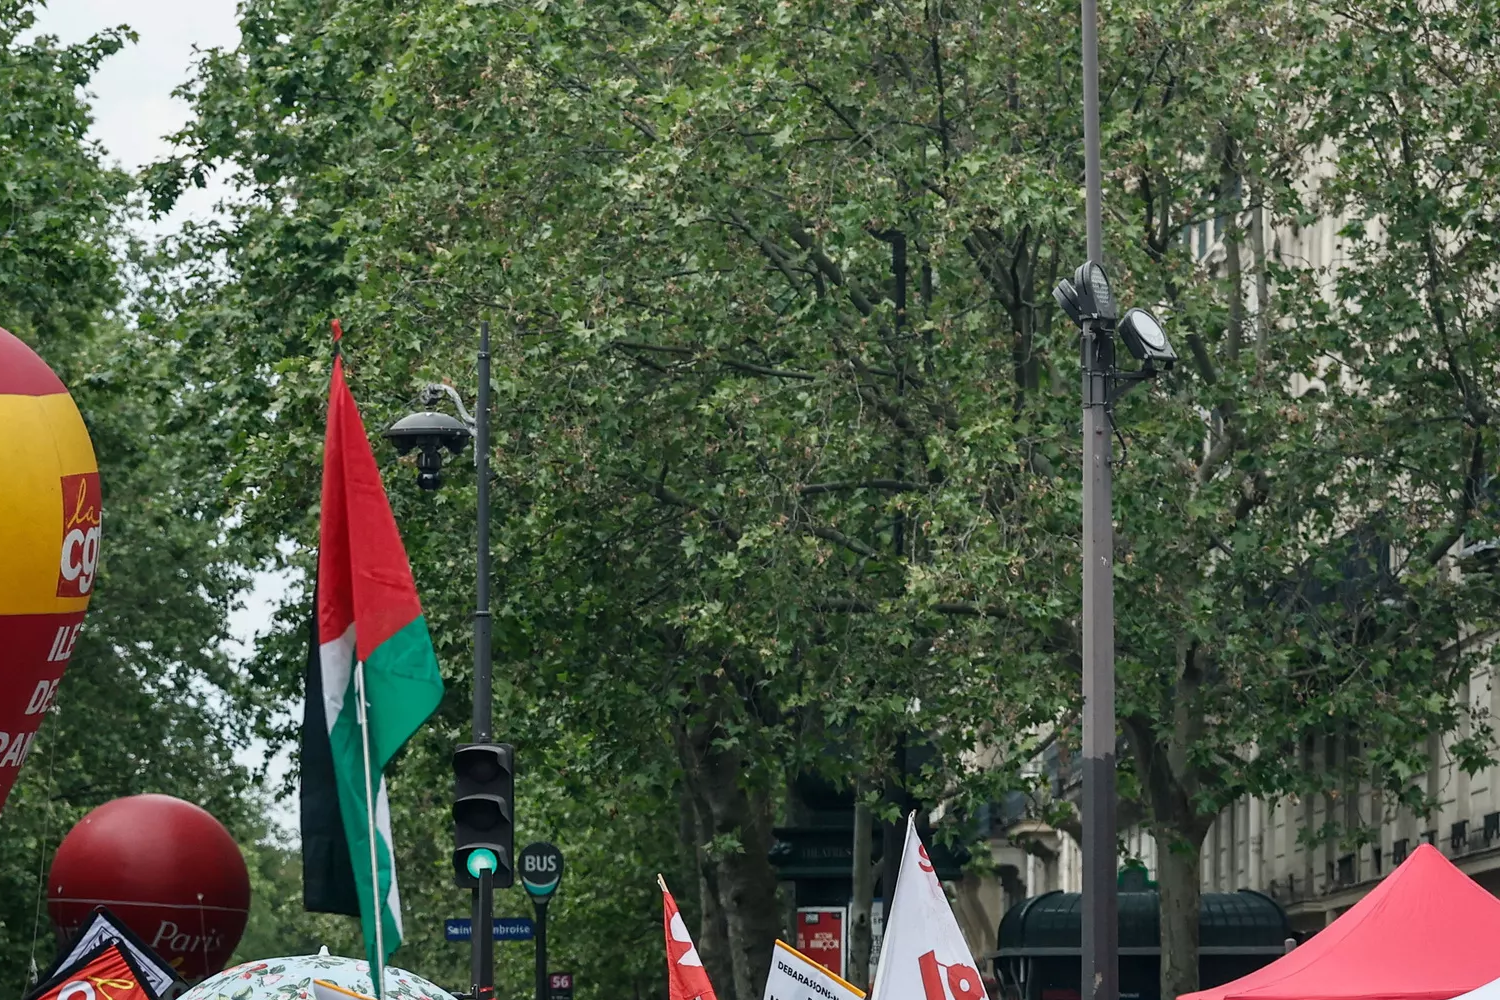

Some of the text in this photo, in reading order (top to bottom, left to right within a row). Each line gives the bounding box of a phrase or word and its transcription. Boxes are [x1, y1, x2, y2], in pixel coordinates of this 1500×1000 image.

[60, 511, 102, 594] cg
[524, 855, 557, 872] BUS
[551, 975, 570, 989] 56
